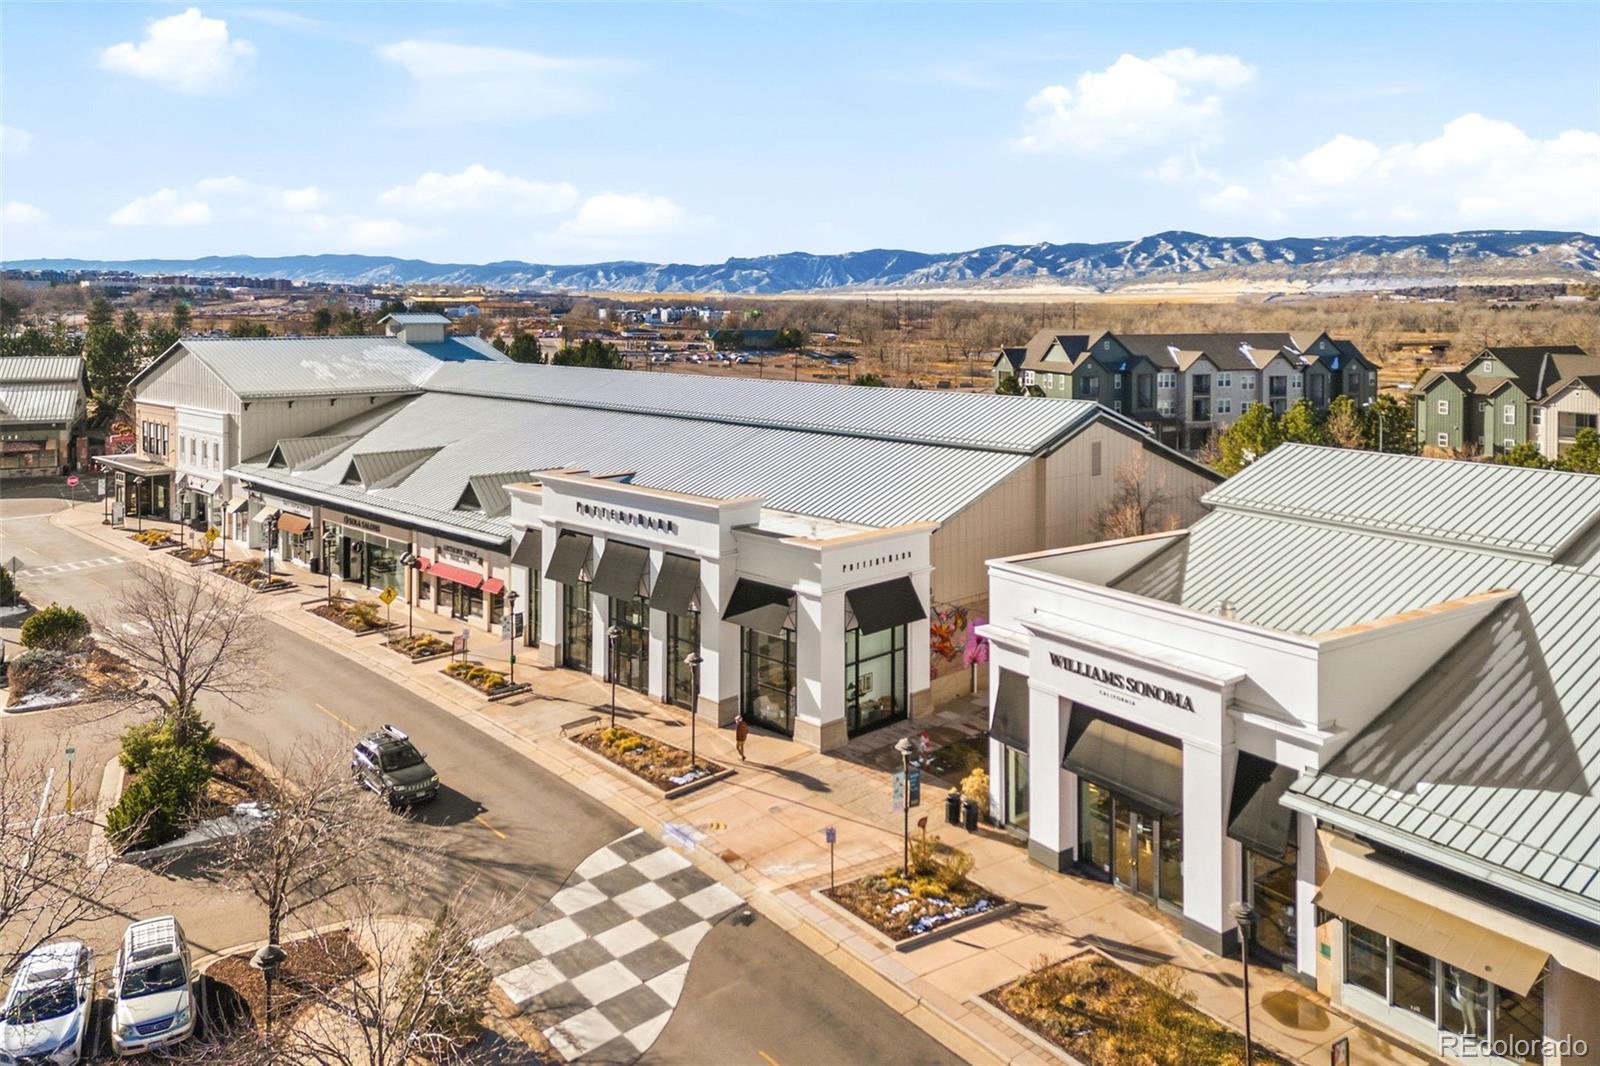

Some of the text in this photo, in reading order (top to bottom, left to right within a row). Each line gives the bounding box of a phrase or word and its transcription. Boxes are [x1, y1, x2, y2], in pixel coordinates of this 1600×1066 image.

[1049, 651, 1196, 713] WILLIAMS SONOMA
[1098, 689, 1136, 706] CALIFORNIA
